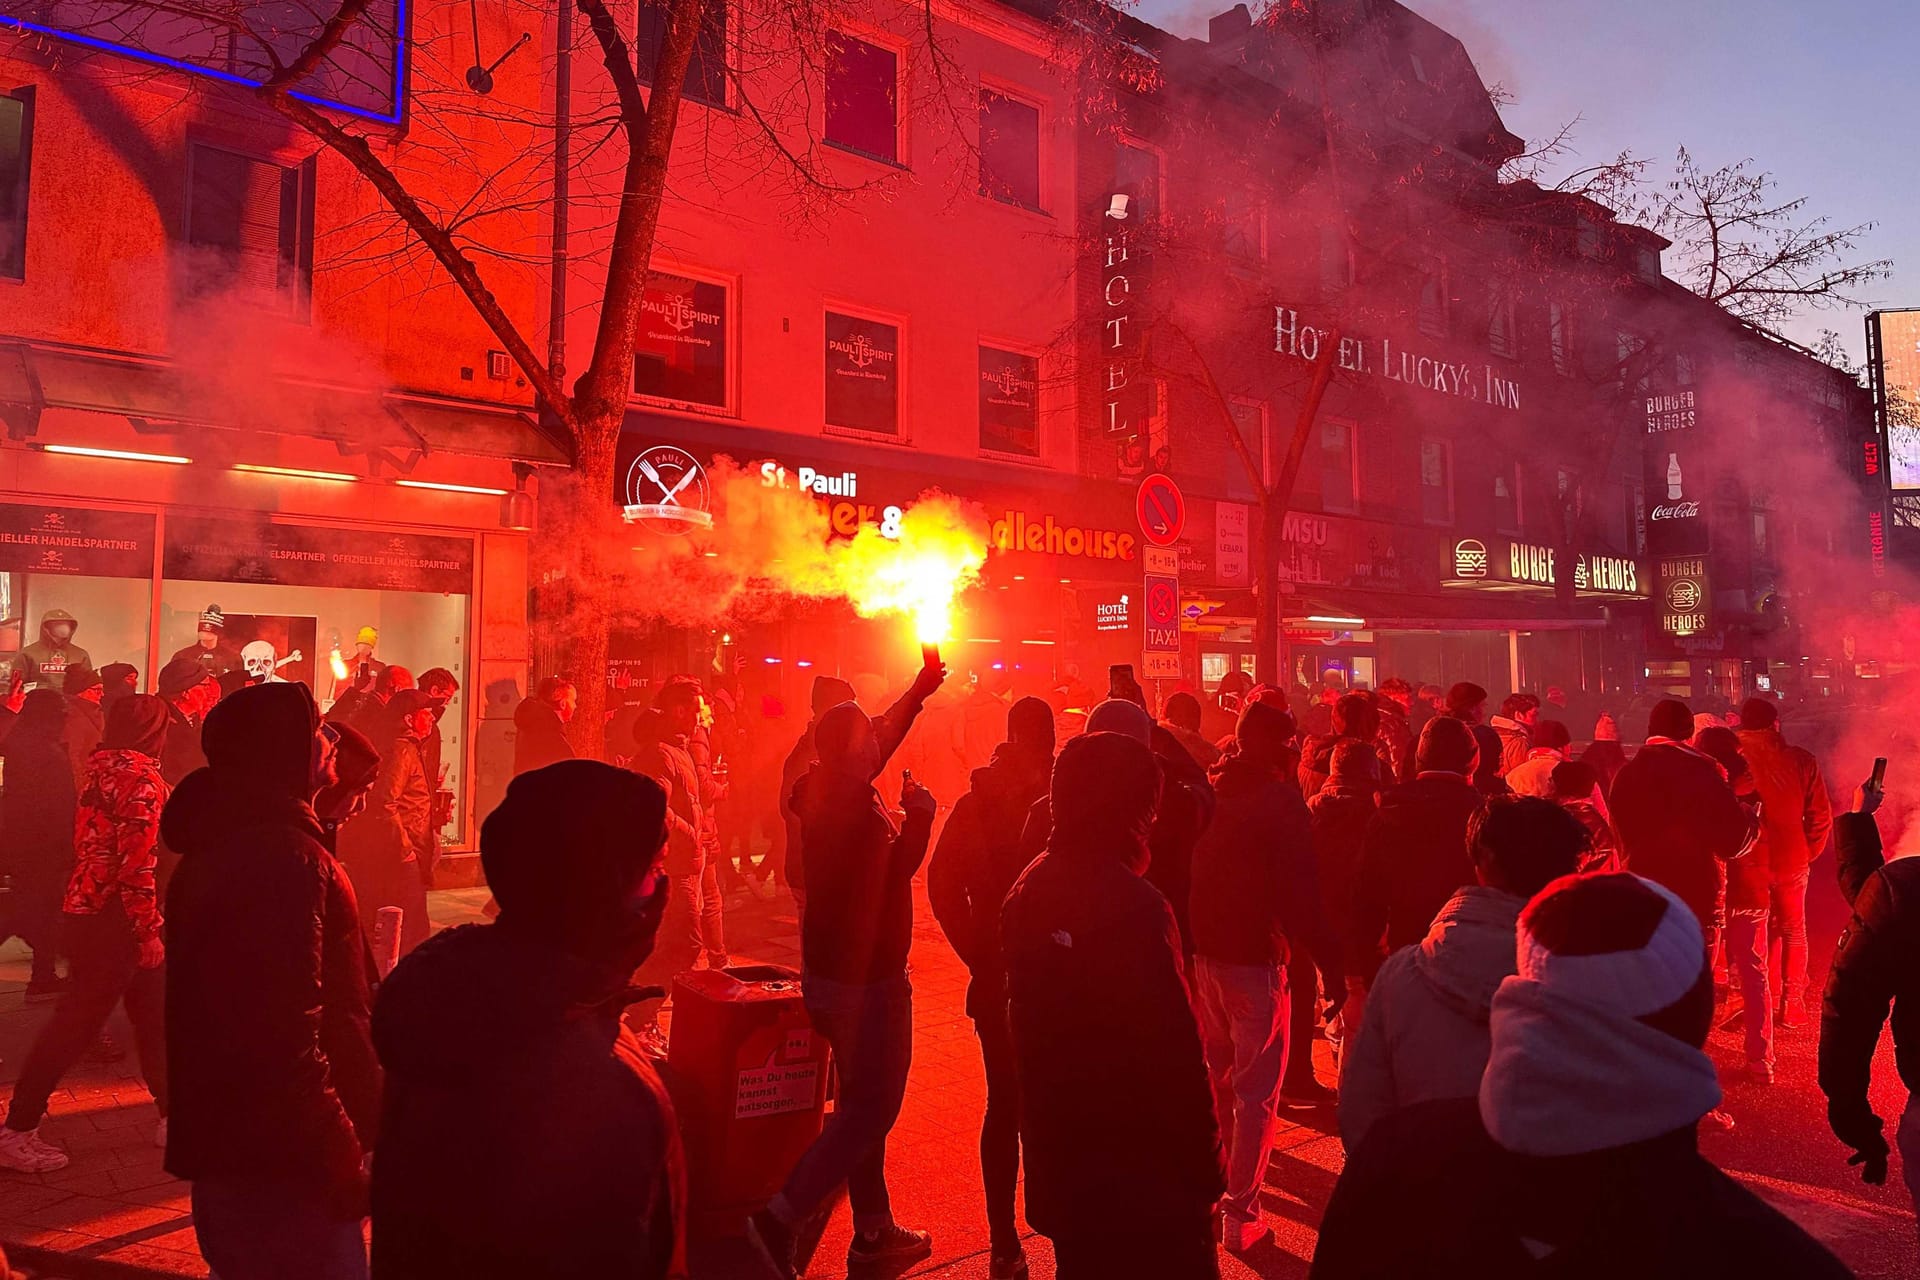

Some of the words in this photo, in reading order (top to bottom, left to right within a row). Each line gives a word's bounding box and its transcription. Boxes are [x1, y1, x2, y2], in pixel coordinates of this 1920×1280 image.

[641, 300, 676, 317] PAULI
[682, 308, 720, 325] SPIRIT
[1105, 230, 1128, 432] HOTEL
[829, 340, 859, 355] PAULI
[862, 347, 895, 362] SPIRIT
[982, 371, 1006, 385] PAULI
[1010, 377, 1035, 391] SPIRIT
[1646, 391, 1695, 413] BURGER
[1647, 411, 1696, 433] HEROES
[655, 453, 685, 466] PAULI
[1864, 441, 1879, 476] WELT
[760, 462, 790, 489] St.
[799, 467, 857, 498] Pauli
[1651, 501, 1700, 521] Coca-Cola
[41, 535, 137, 551] HANDELSPARTNER
[332, 553, 385, 566] OFFIZIELLER
[387, 555, 460, 570] HANDELSPARTNER
[1510, 542, 1555, 584] BURGE
[1592, 555, 1637, 592] HEROES
[1661, 560, 1703, 578] BURGER
[1097, 603, 1128, 616] HOTEL
[1663, 614, 1706, 631] HEROES
[740, 1075, 763, 1086] Was
[767, 1072, 781, 1082] Du
[740, 1087, 777, 1099] kannst
